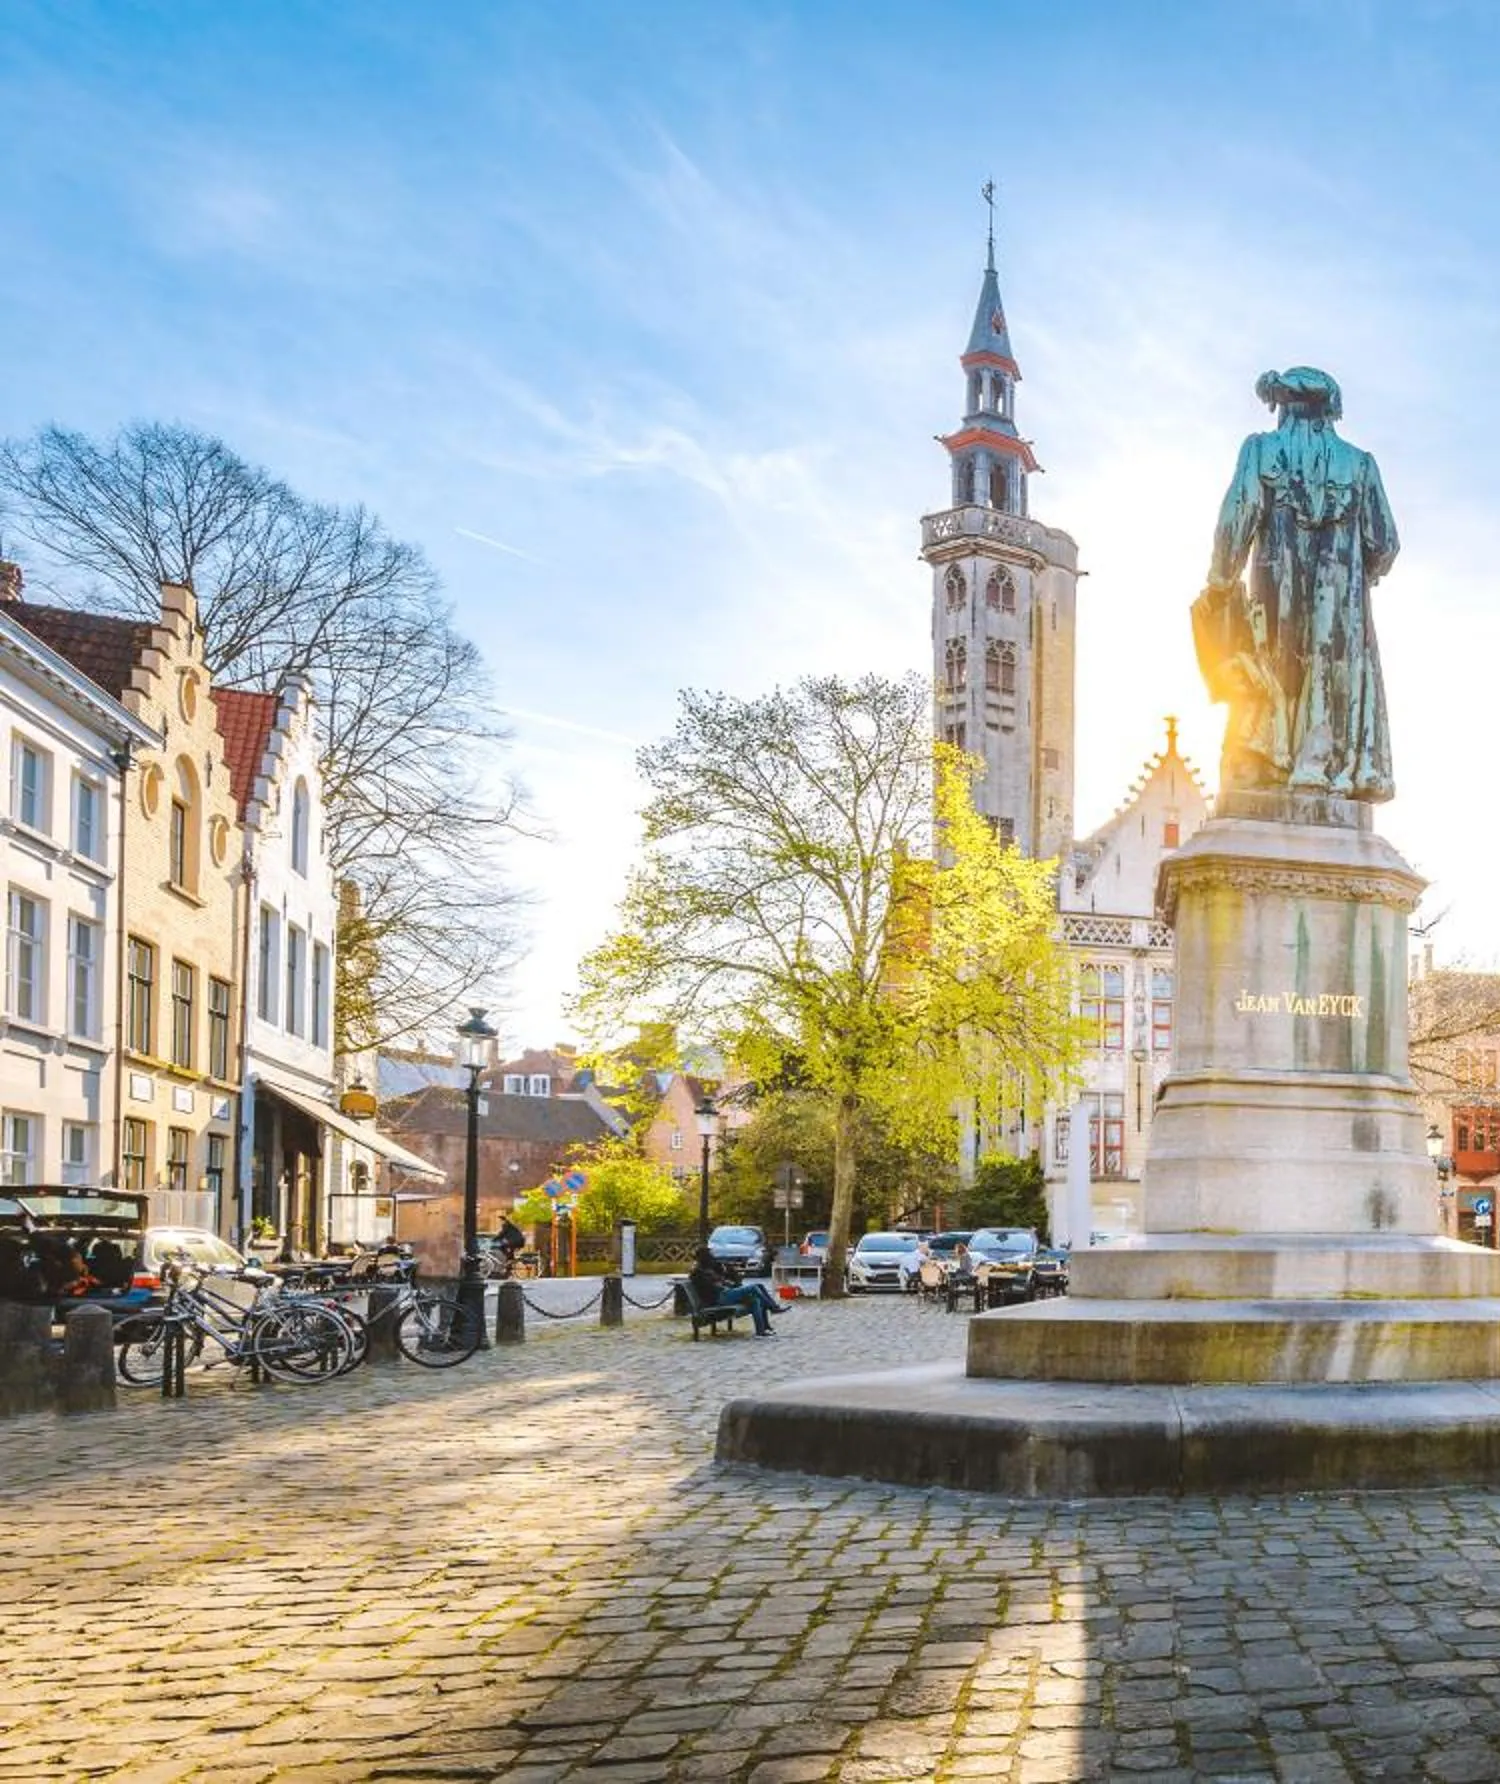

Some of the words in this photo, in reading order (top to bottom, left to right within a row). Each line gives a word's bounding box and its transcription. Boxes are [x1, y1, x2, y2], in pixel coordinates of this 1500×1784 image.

[1236, 989, 1280, 1013] JEAN
[1281, 991, 1317, 1015] VAN
[1319, 993, 1364, 1018] EYCK
